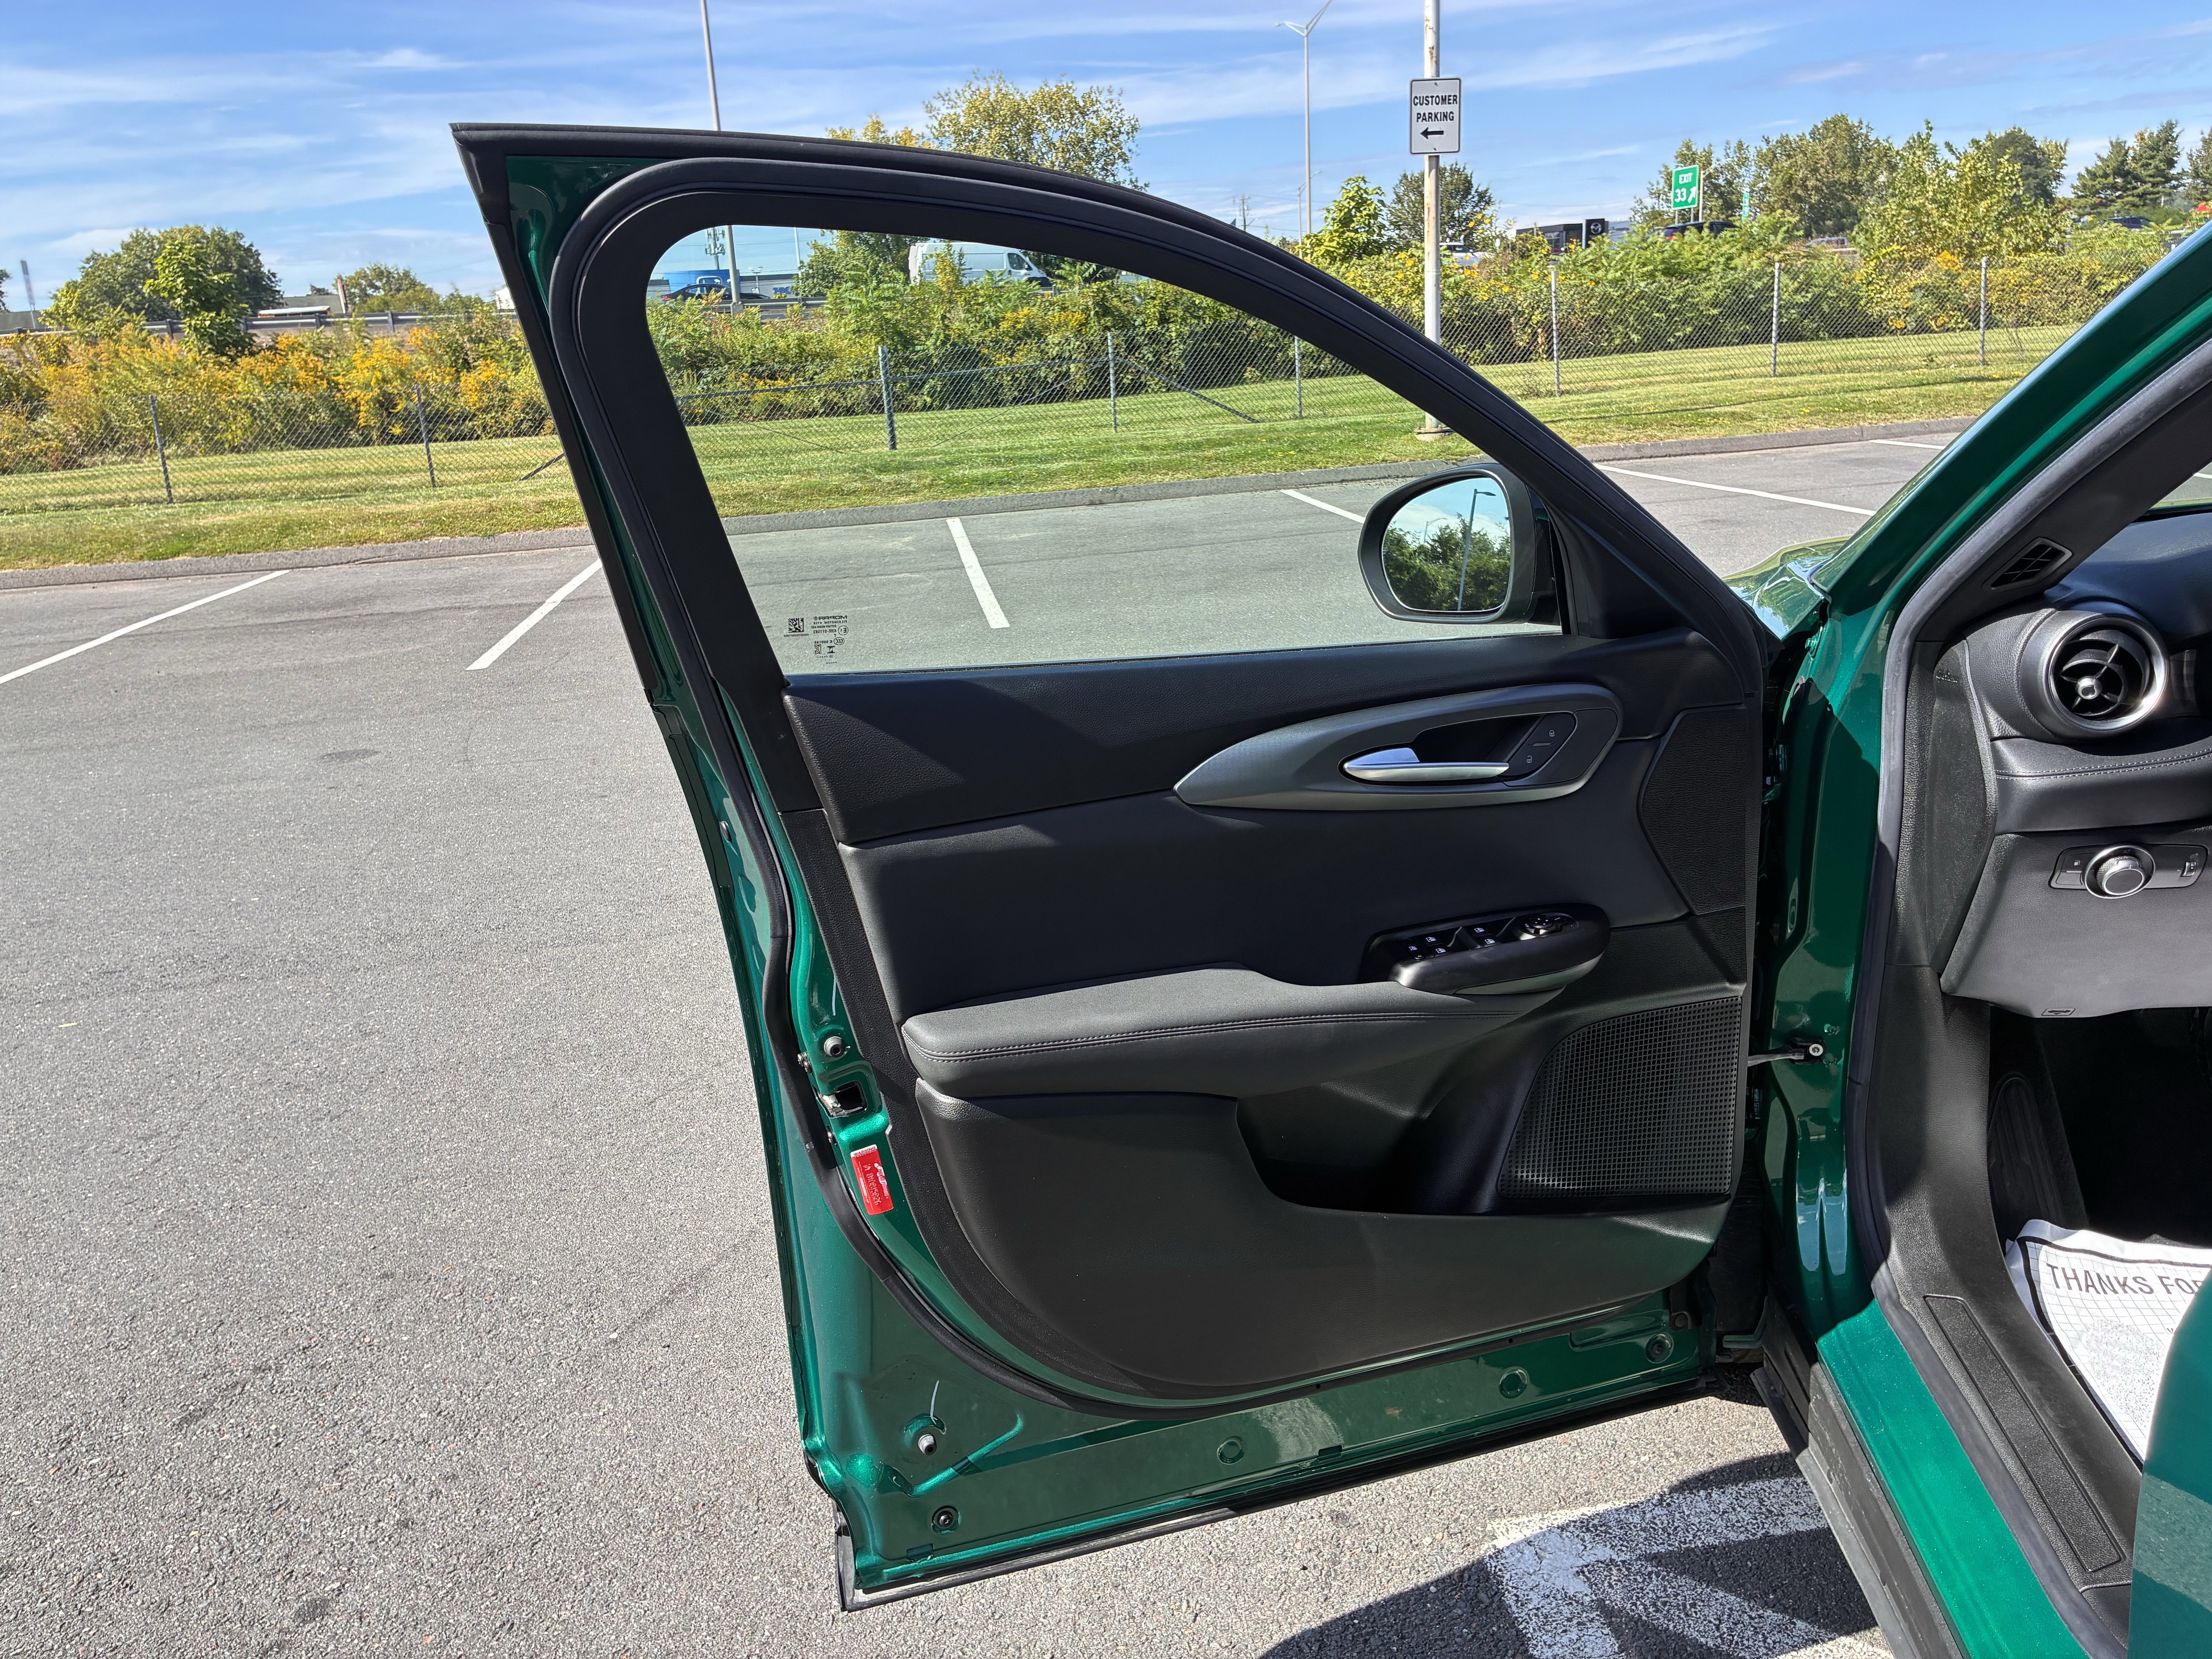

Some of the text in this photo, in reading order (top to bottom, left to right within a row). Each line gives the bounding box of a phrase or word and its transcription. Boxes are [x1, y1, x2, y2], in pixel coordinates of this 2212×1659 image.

[1413, 94, 1458, 106] CUSTOMER
[1416, 111, 1454, 122] PARKING
[1679, 172, 1693, 184] EXIT
[1674, 187, 1686, 203] 33
[854, 1146, 876, 1156] WARNING
[2046, 1262, 2154, 1295] THANKS
